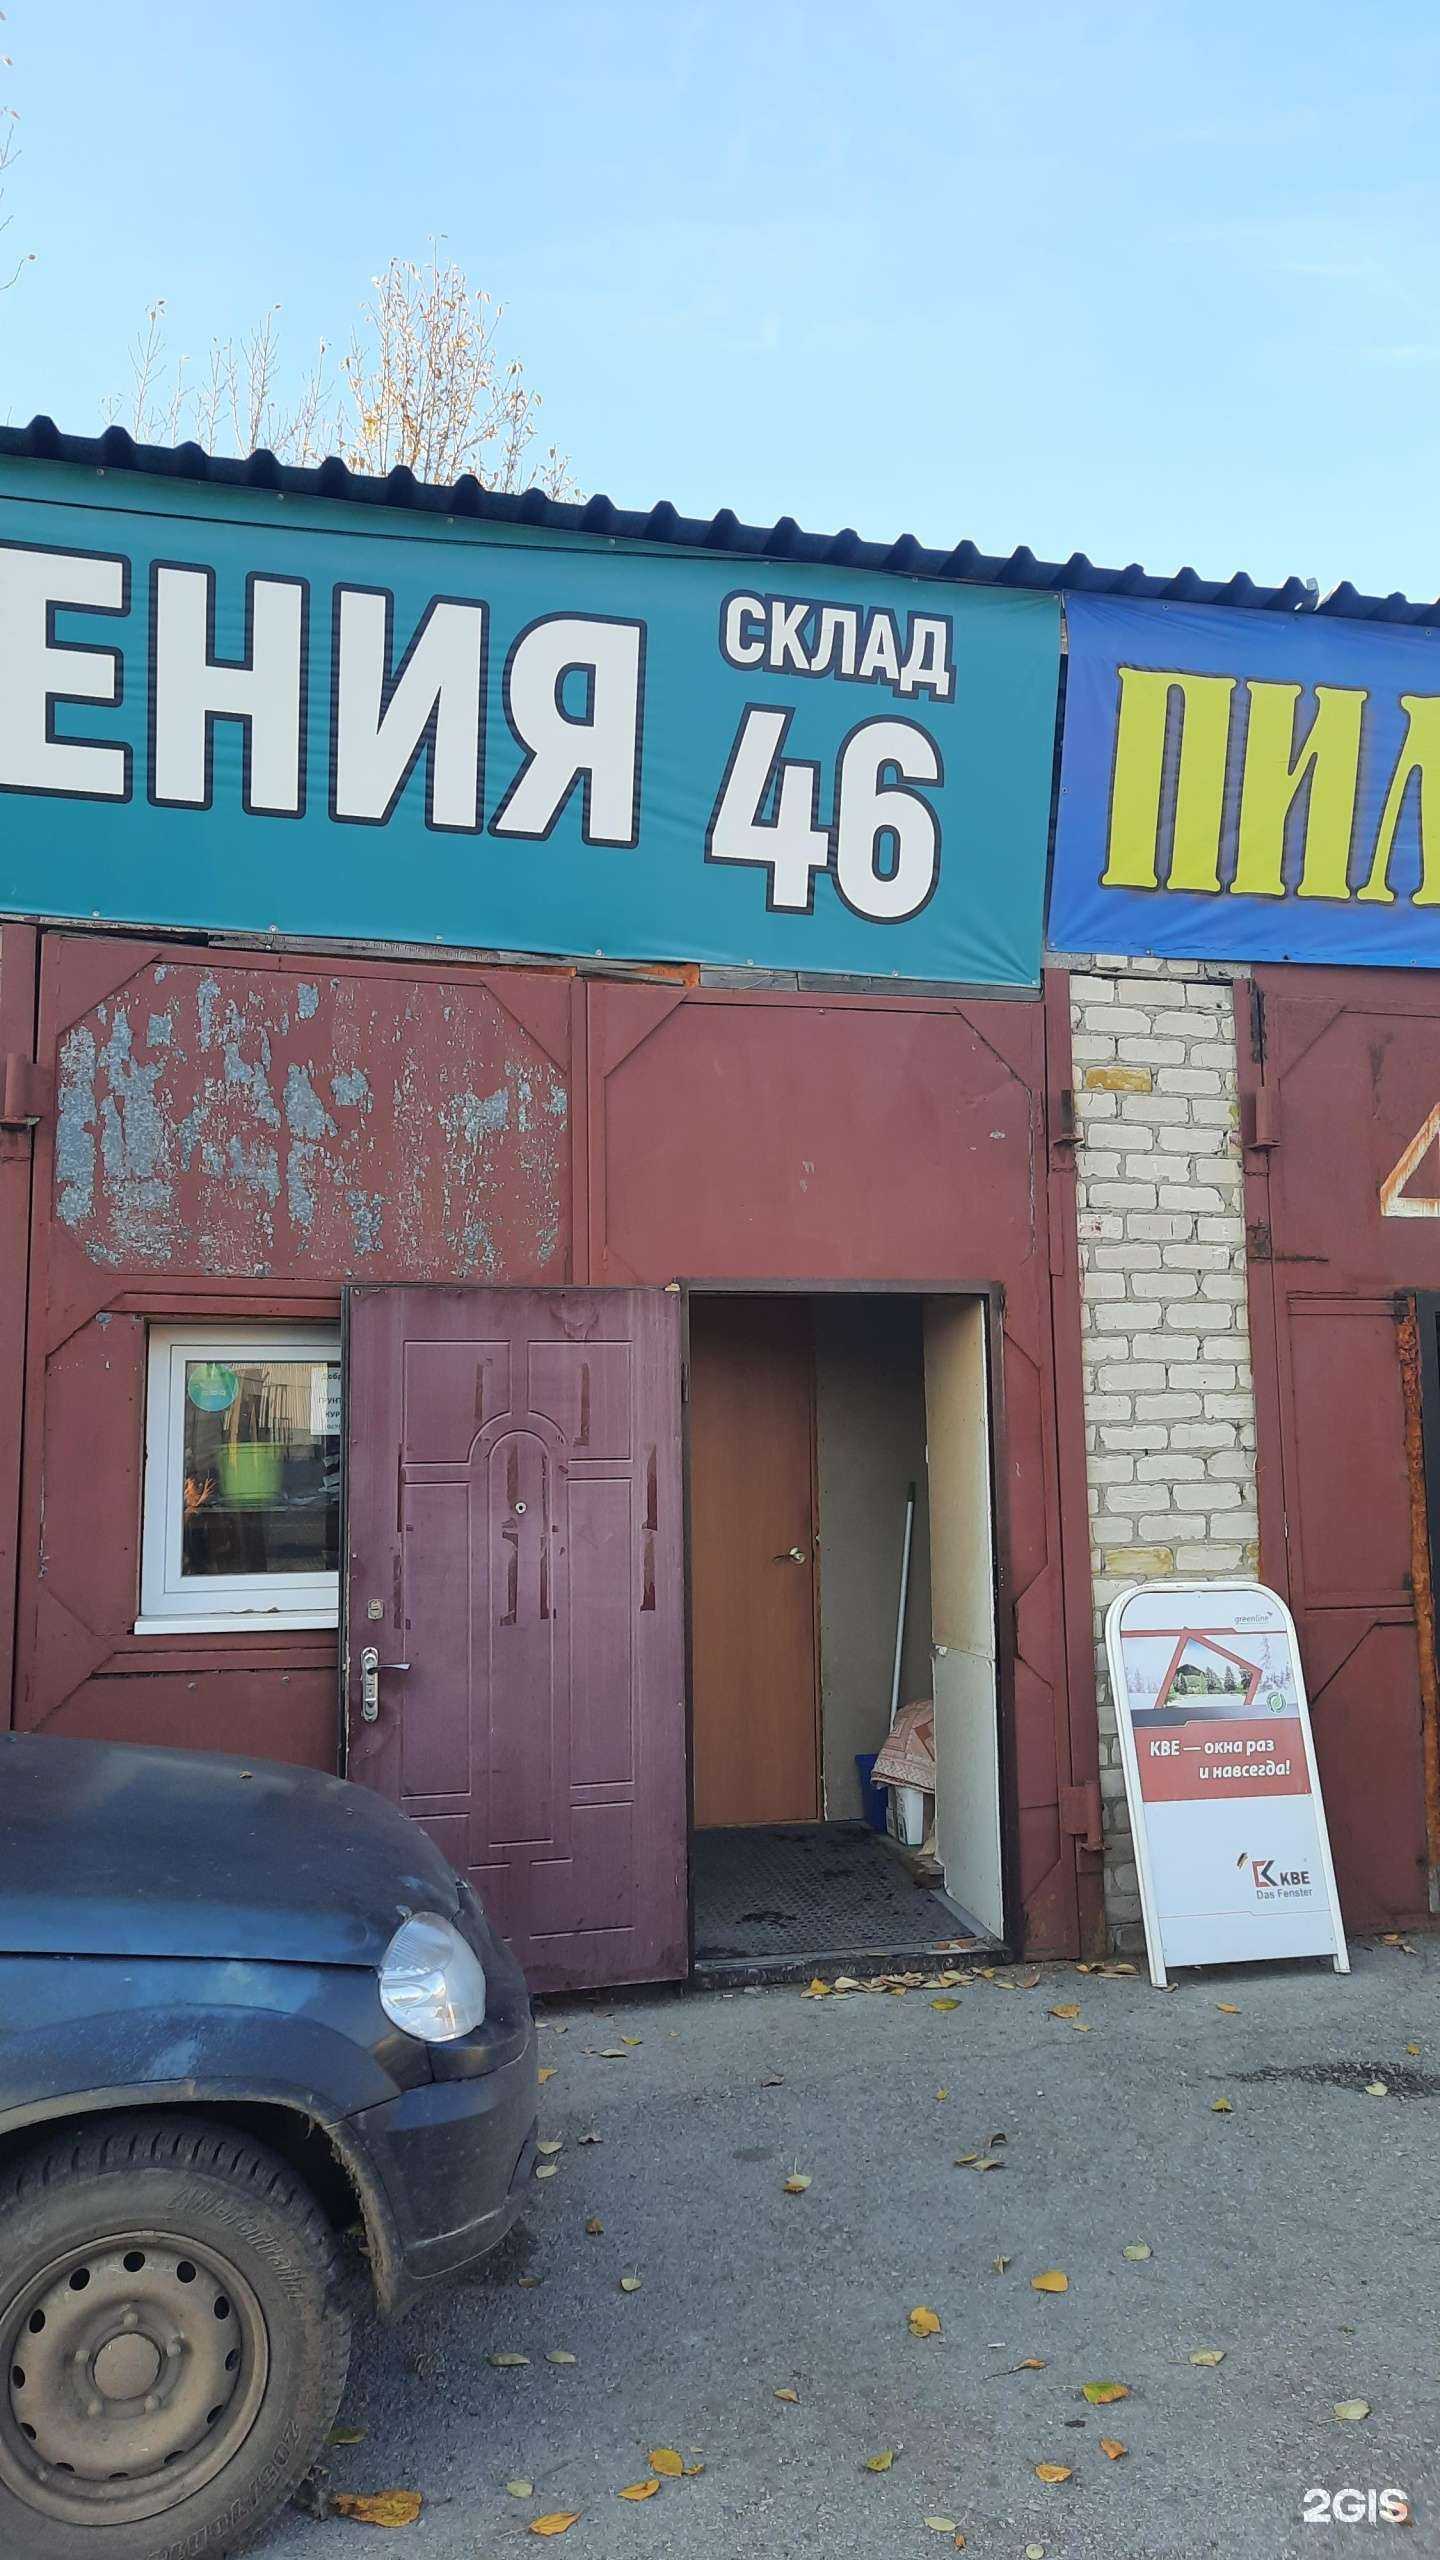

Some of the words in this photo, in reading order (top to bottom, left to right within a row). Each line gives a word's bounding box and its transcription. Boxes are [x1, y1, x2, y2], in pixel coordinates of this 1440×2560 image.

[719, 588, 957, 703] СКЛАД
[0, 540, 648, 849] ЕНИЯ
[704, 702, 945, 926] 46
[1204, 1740, 1243, 1754] окна
[1246, 1739, 1275, 1756] раз
[1199, 1766, 1209, 1779] и
[1212, 1760, 1291, 1779] навсегда!
[1280, 1871, 1311, 1886] KBE
[1256, 1889, 1275, 1899] Das
[1277, 1887, 1312, 1898] Fenster
